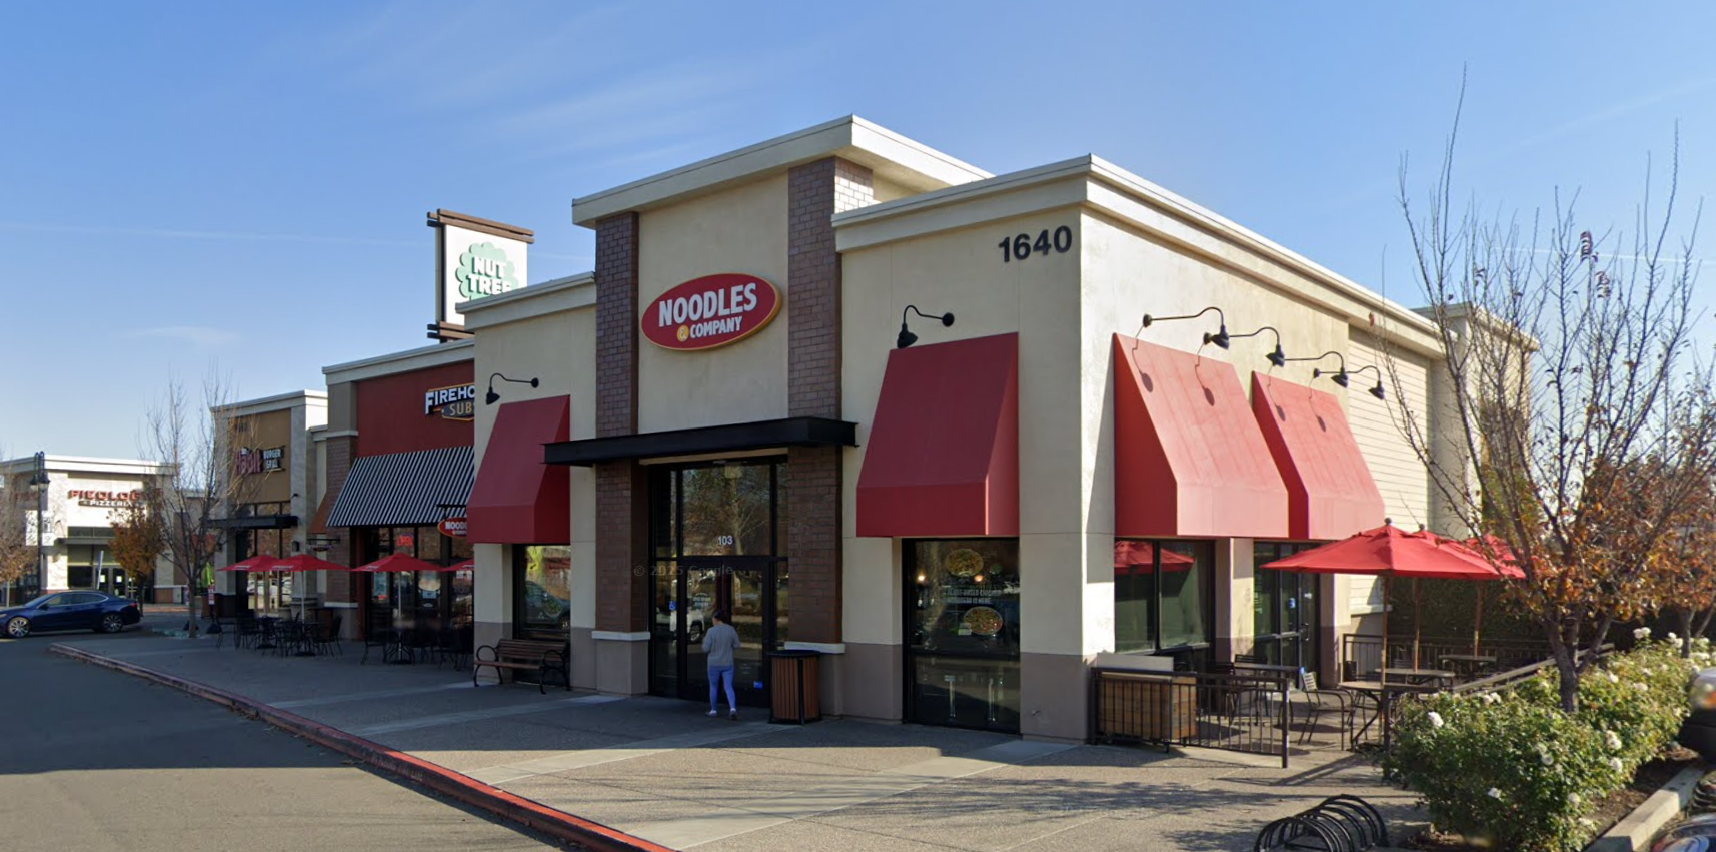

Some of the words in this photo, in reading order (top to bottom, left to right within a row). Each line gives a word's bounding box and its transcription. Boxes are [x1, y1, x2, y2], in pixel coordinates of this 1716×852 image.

[998, 225, 1073, 263] 1640
[471, 256, 507, 279] NUT
[658, 282, 757, 327] NOODLES
[690, 316, 742, 338] COMPANY
[717, 535, 733, 545] 103
